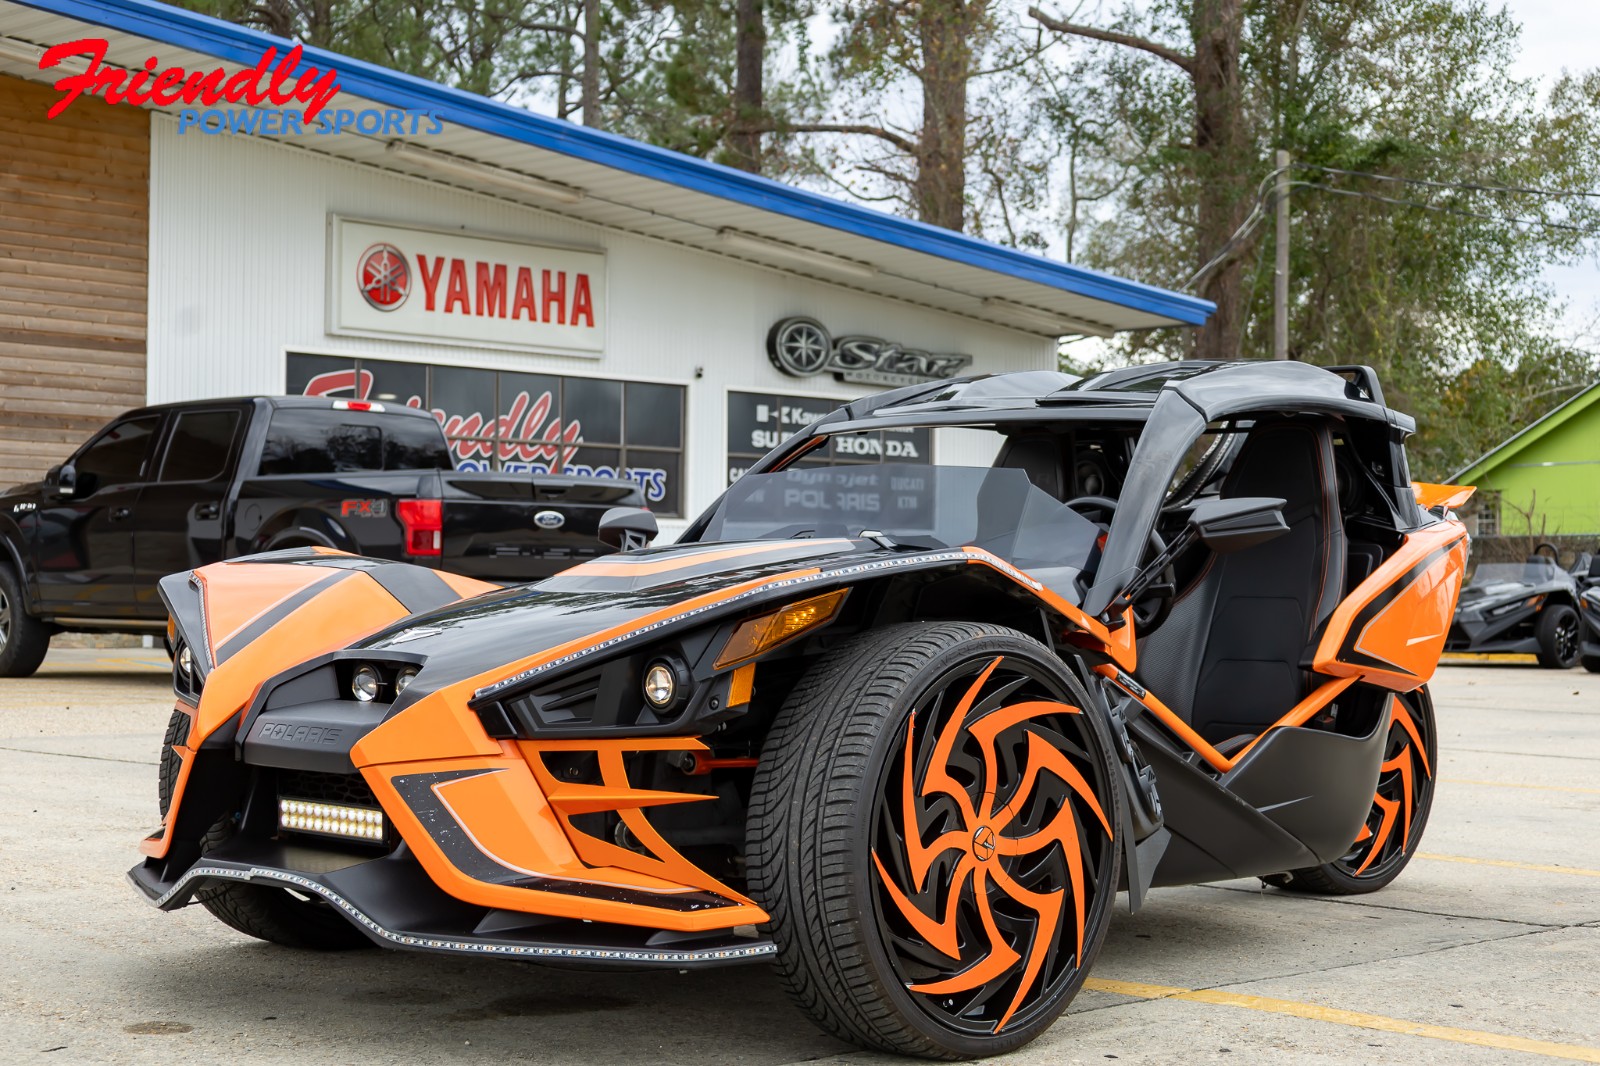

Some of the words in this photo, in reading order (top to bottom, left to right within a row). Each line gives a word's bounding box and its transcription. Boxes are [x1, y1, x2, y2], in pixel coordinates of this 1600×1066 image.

[416, 253, 595, 328] YAMAHA
[836, 436, 919, 459] HONDA
[341, 499, 388, 518] FX4
[259, 723, 343, 744] POLARIS
